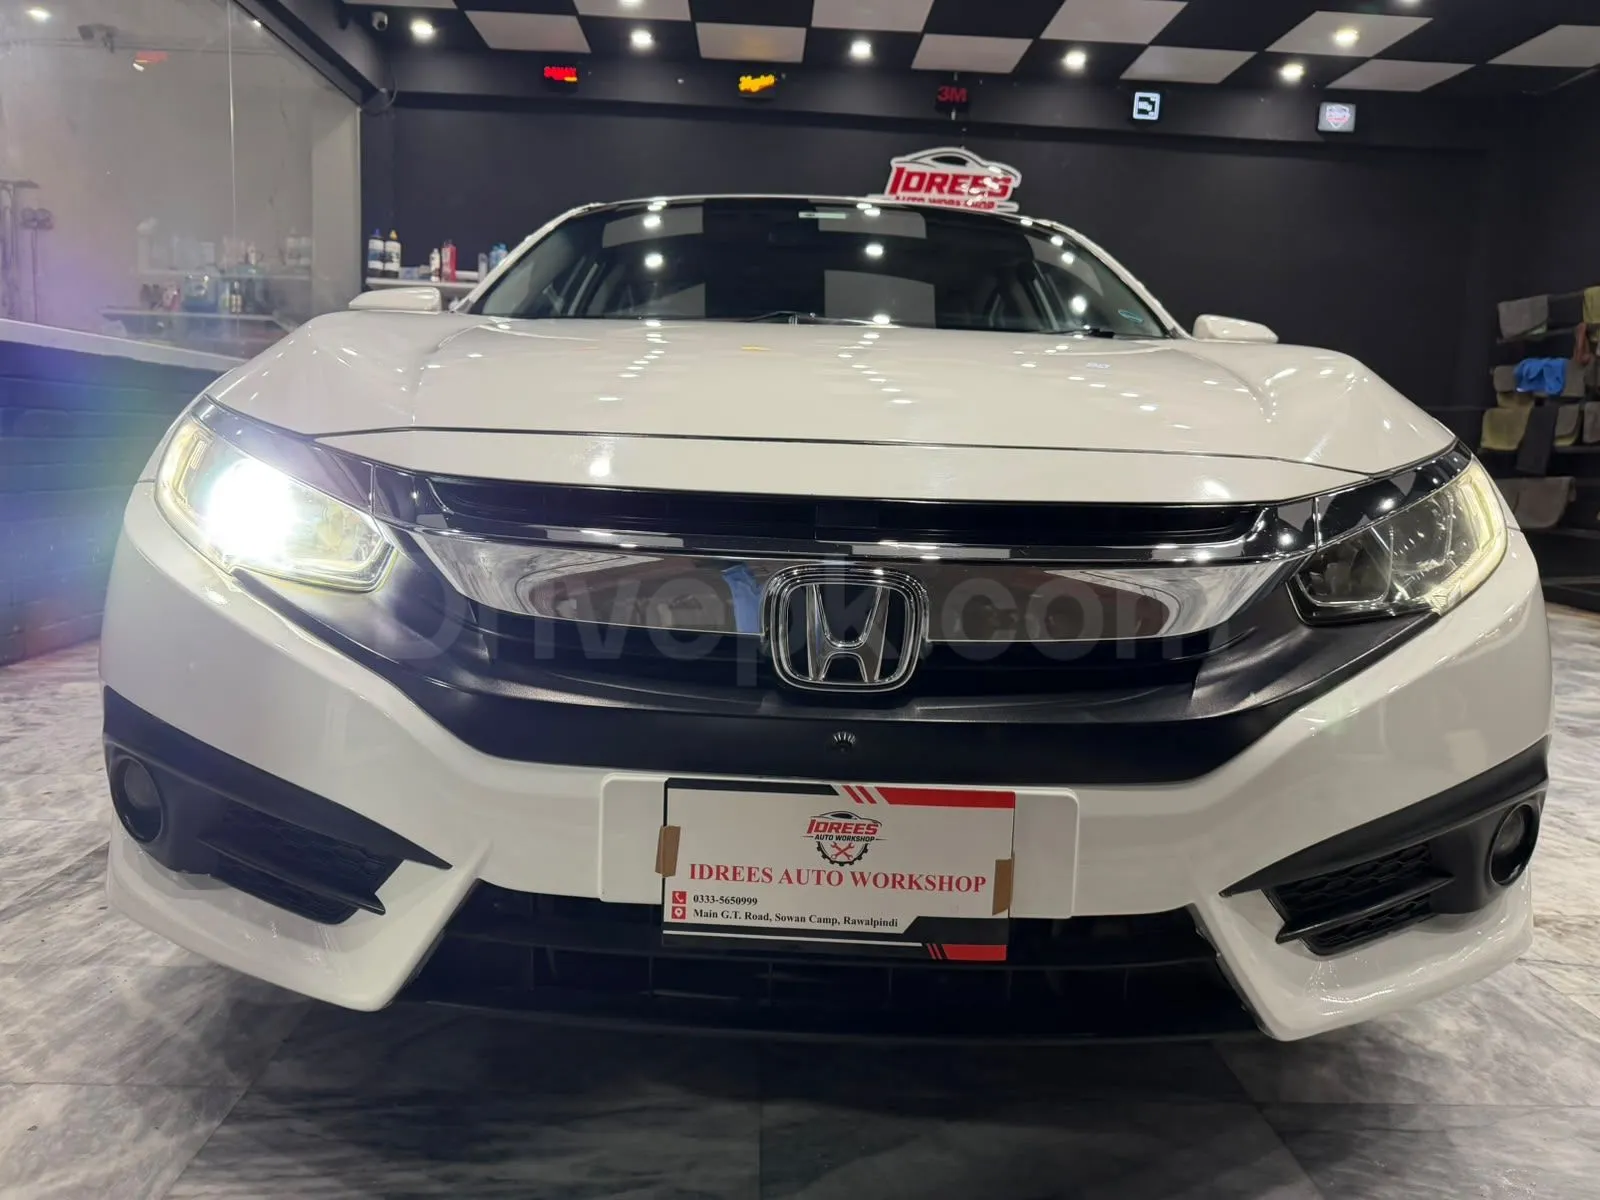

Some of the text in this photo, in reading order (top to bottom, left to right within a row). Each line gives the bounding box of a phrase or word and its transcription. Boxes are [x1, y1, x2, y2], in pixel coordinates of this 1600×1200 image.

[937, 85, 968, 103] 3M
[888, 166, 1012, 198] IDREES
[806, 819, 879, 835] IDREES
[689, 863, 987, 893] IDREES AUTO WORKSHOP
[693, 894, 758, 906] 0333-5650999
[693, 908, 898, 928] Main G.T. Road, Sowan Camp, Rawalpindi
